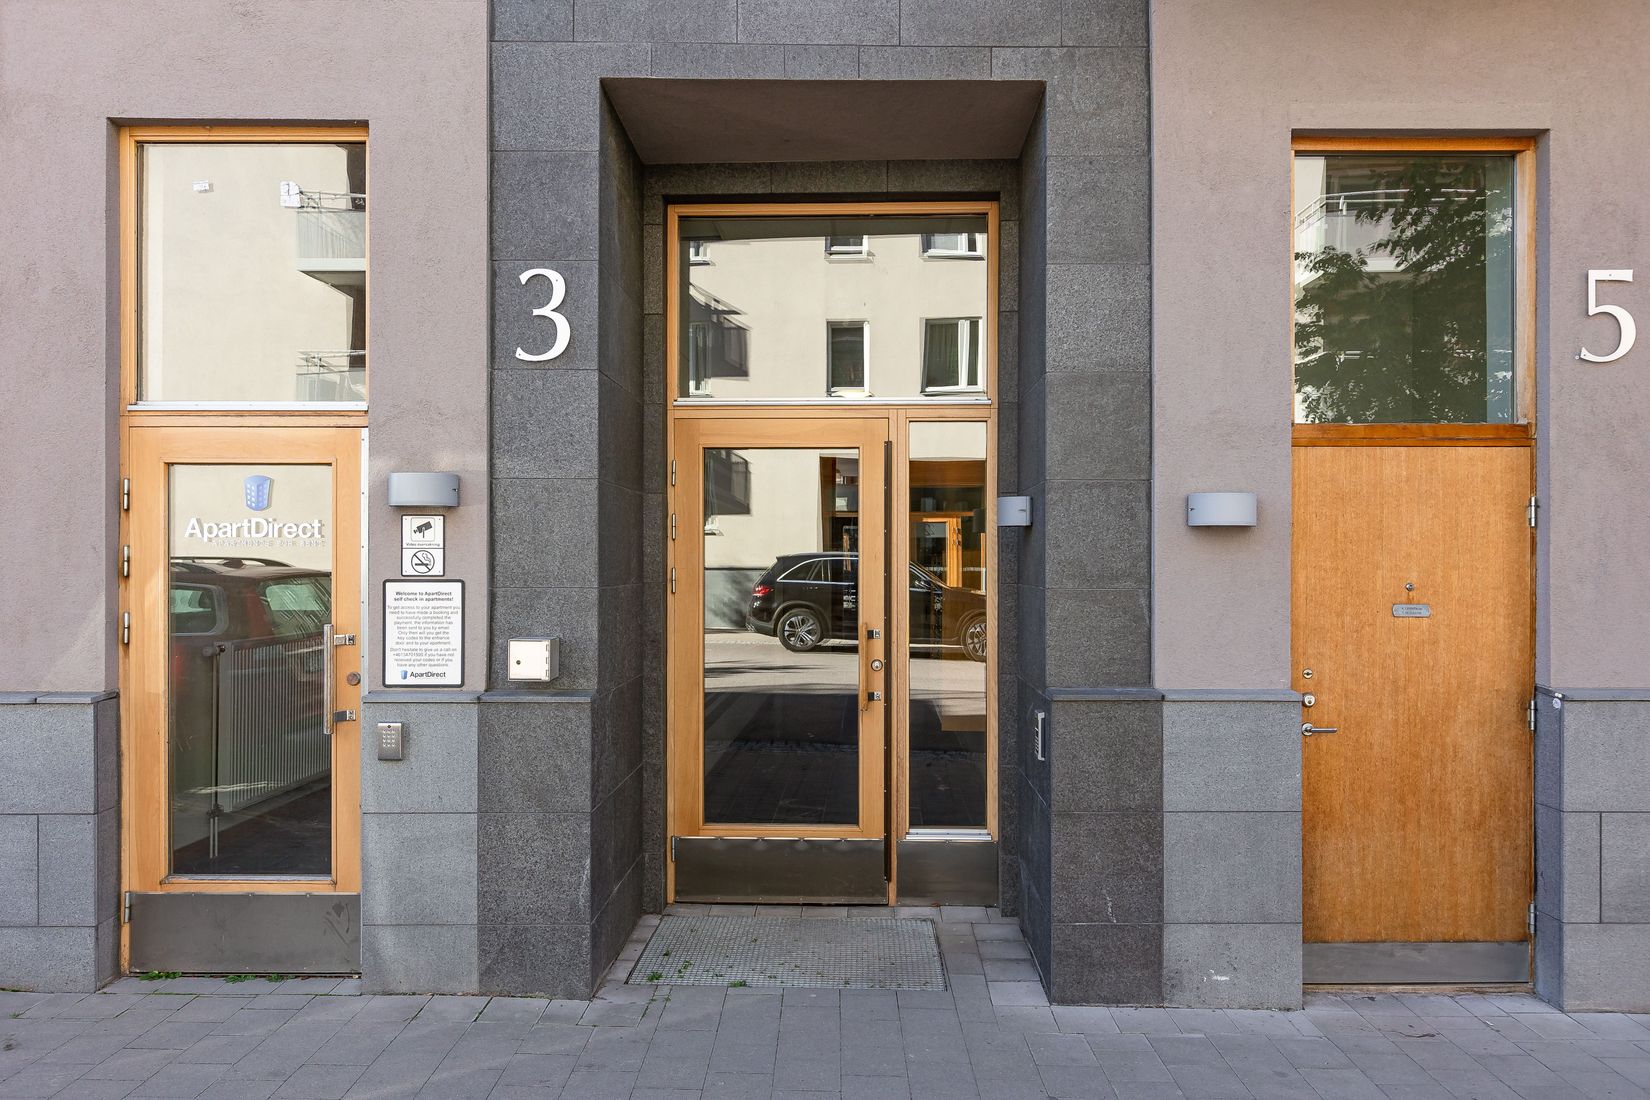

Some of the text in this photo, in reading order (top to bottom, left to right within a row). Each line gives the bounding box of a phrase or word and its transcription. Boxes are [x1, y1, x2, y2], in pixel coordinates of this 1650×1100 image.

[515, 268, 571, 362] 3
[1580, 269, 1636, 362] 5
[184, 517, 323, 542] ApartDirect
